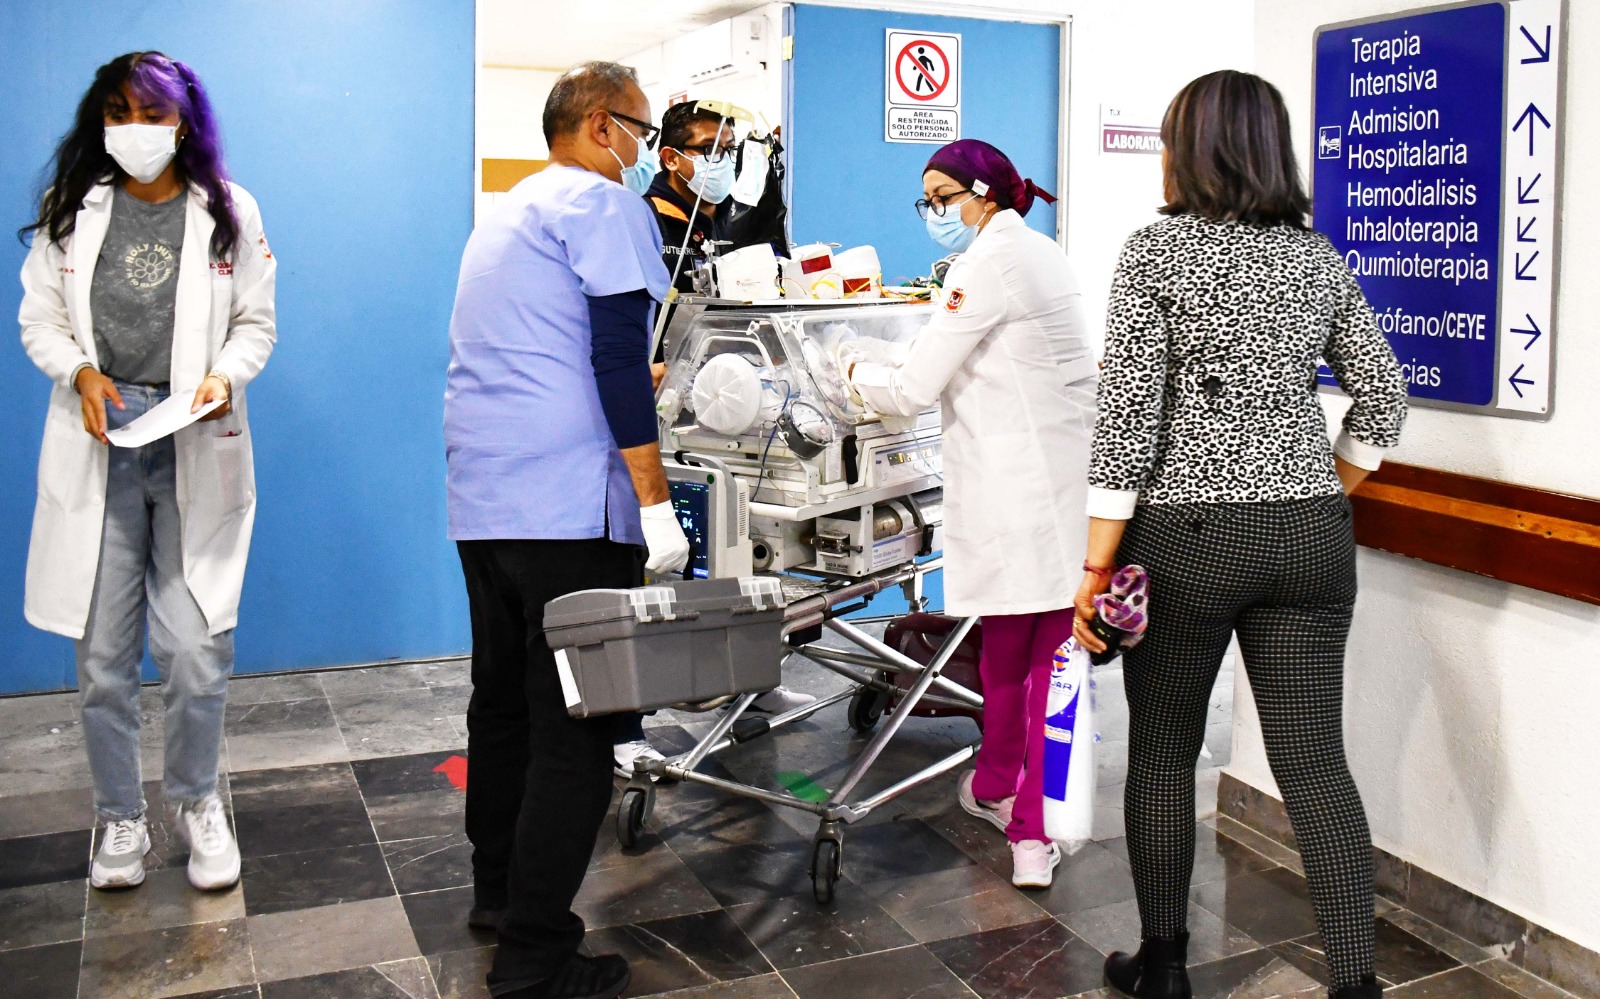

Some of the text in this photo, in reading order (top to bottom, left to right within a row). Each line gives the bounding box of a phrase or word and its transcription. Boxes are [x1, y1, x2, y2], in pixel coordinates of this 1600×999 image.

[1351, 30, 1420, 65] Terapia
[1350, 65, 1437, 98] Intensiva
[897, 117, 949, 125] RESTRINGIDA
[898, 131, 948, 139] AUTORIZADO
[1348, 104, 1439, 136] Admision
[1106, 133, 1163, 151] LABORATO
[1348, 137, 1467, 175] Hospitalaria
[1347, 177, 1477, 207] Hemodialisis
[1346, 214, 1478, 249] Inhaloterapia
[125, 243, 173, 264] HOLY SHIT
[1373, 306, 1486, 340] rófano/CEYE
[682, 517, 693, 530] 94
